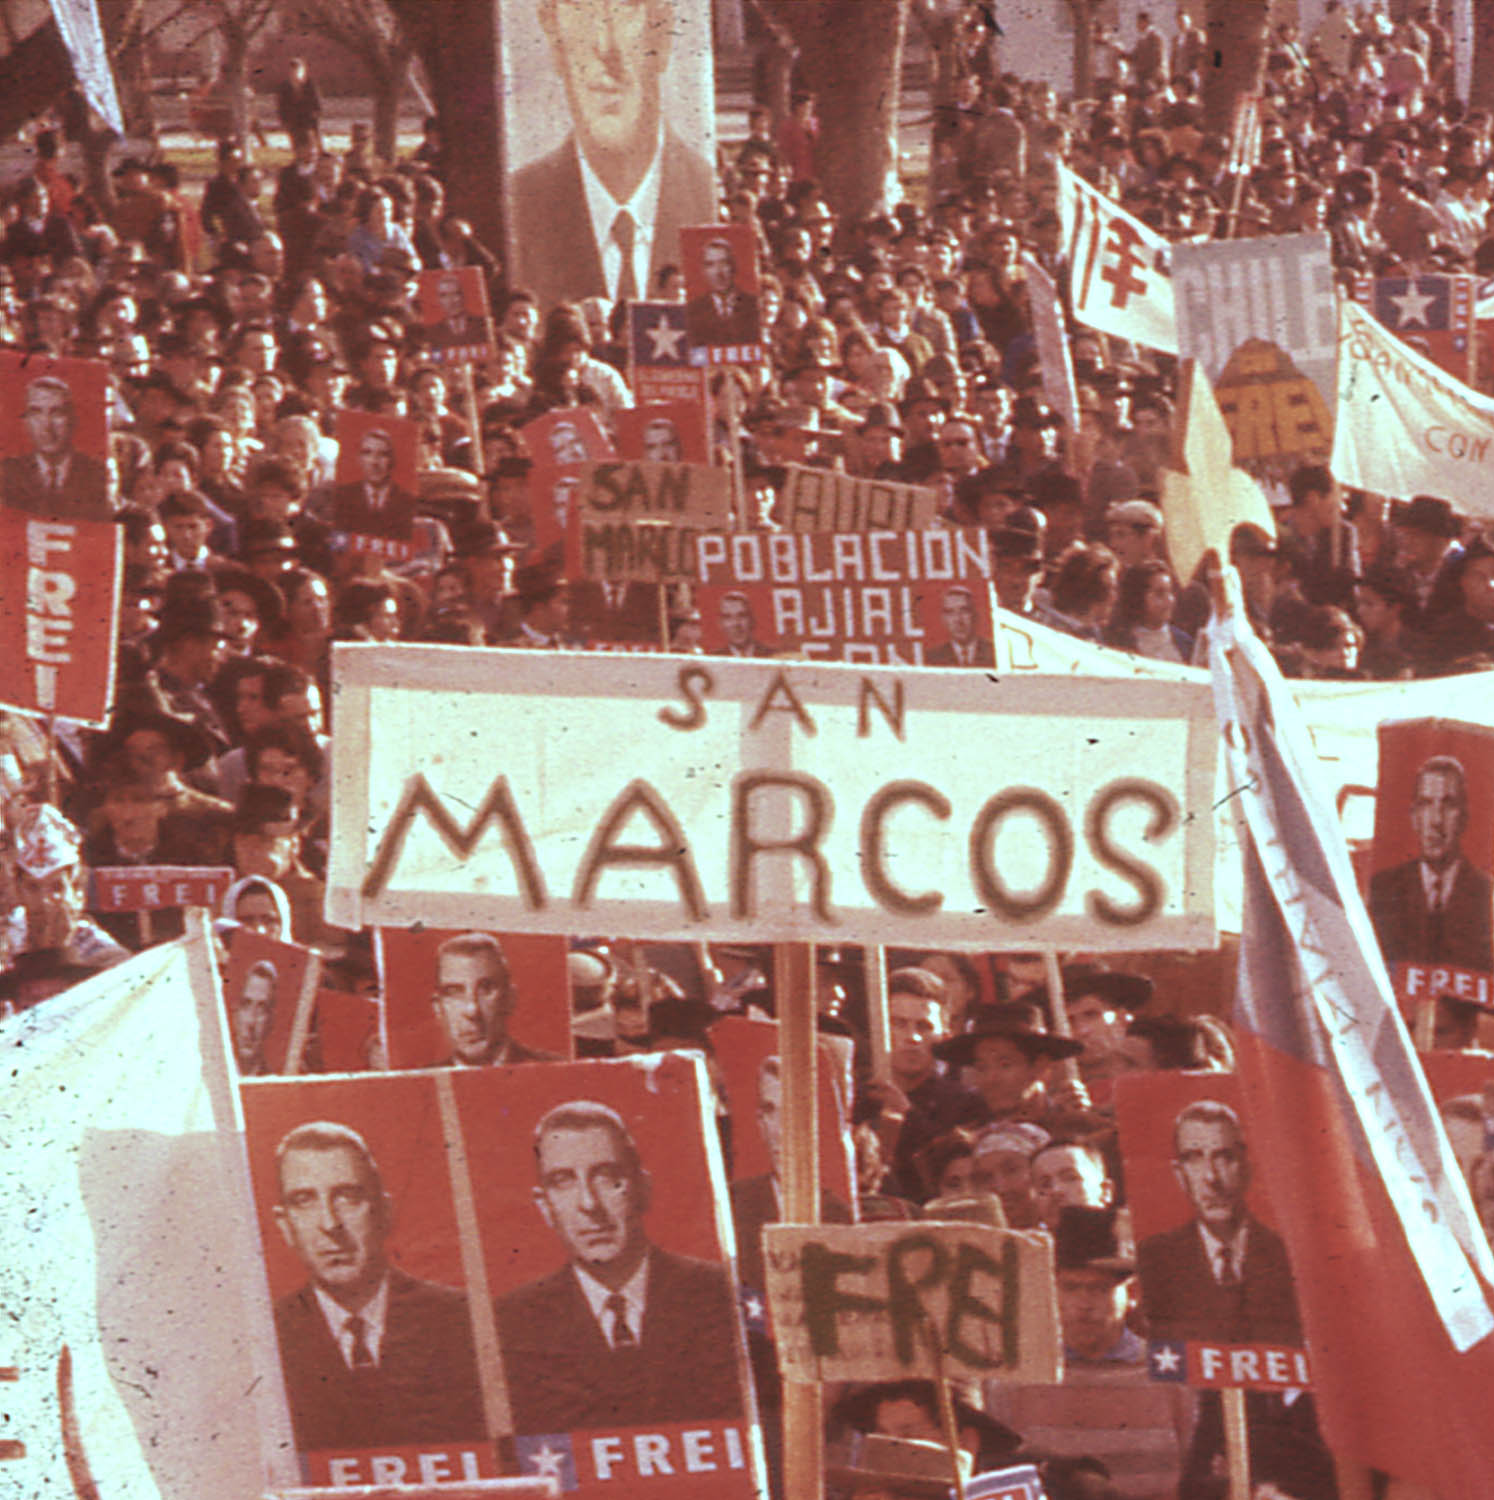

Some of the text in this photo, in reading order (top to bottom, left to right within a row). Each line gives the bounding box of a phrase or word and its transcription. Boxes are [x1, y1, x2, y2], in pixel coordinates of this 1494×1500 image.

[588, 463, 691, 512] SAN
[696, 528, 991, 583] POBLACION
[27, 519, 77, 711] FREI
[772, 585, 925, 637] AJIAL
[657, 665, 906, 742] SAN
[361, 770, 1180, 928] MARCOS
[1406, 966, 1488, 998] FREI
[1201, 1345, 1310, 1384] FREI
[328, 1451, 482, 1488] FREI
[592, 1426, 745, 1480] FREI
